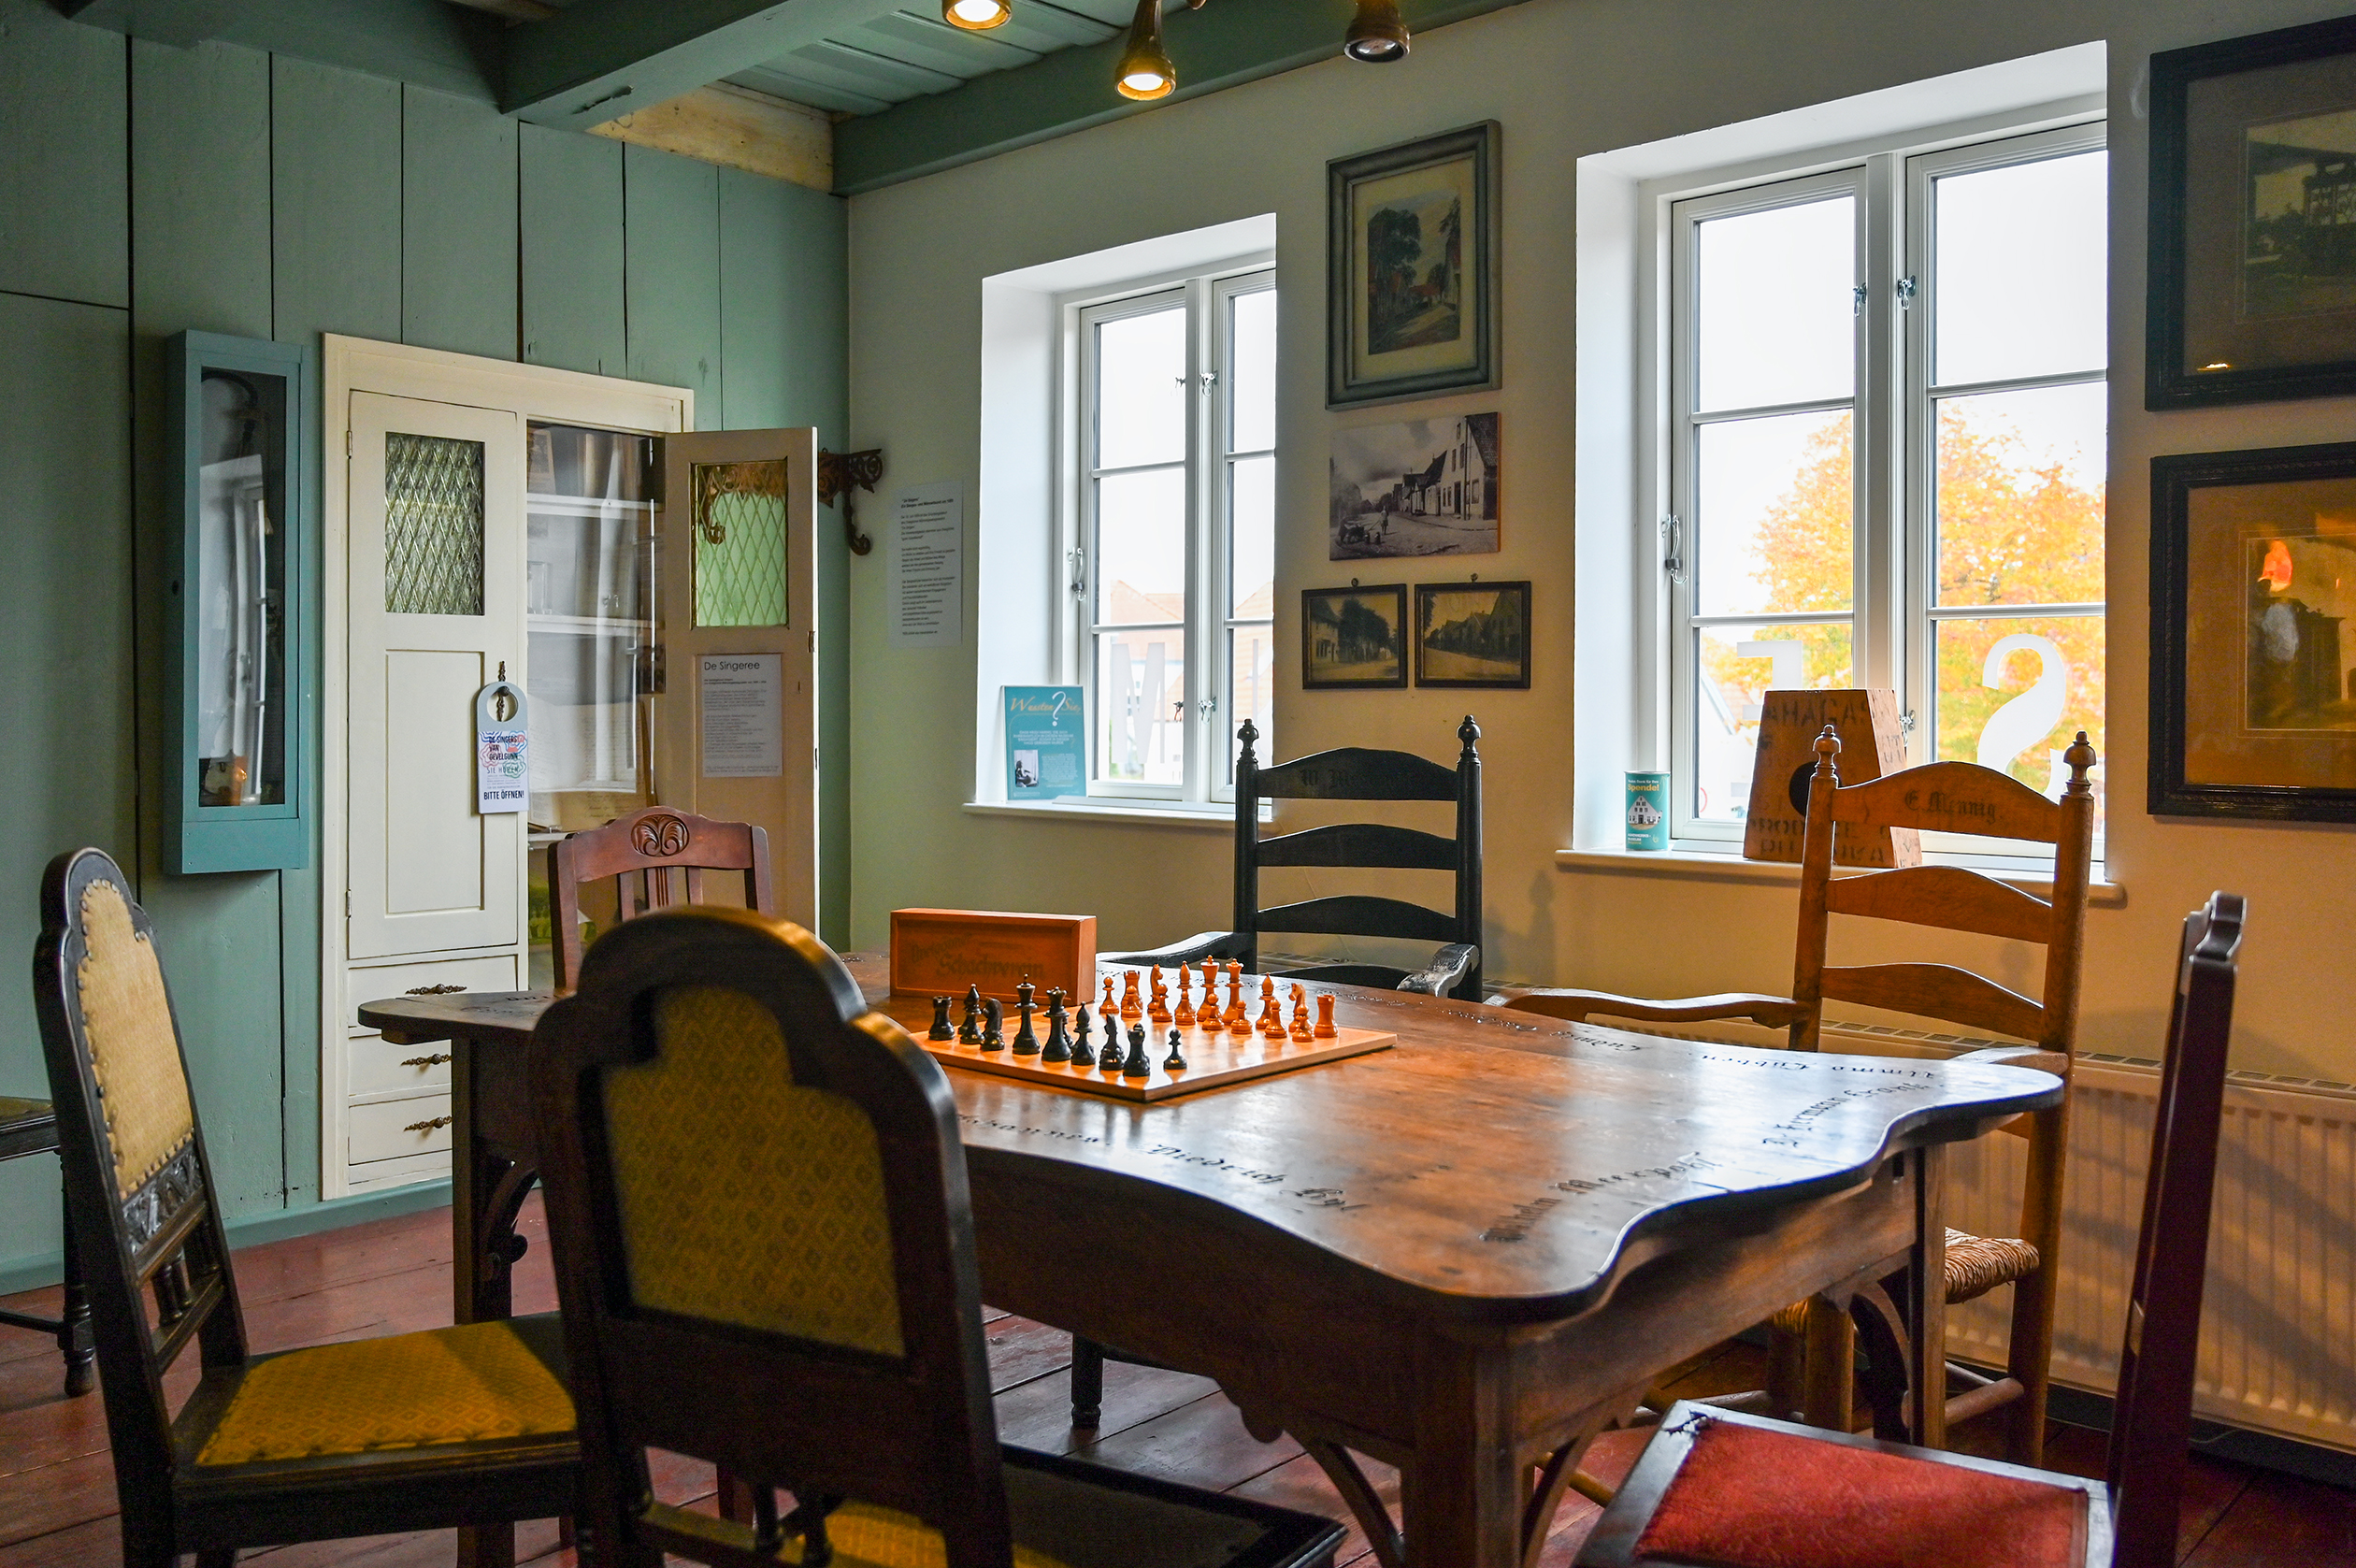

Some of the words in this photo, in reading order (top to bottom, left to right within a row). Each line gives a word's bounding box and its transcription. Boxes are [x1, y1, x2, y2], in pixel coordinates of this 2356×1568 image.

[704, 661, 718, 670] De
[719, 661, 761, 672] Singeree
[1628, 784, 1659, 792] Spende!
[483, 791, 499, 800] BITTE
[501, 789, 524, 799] ÖFFNEN!
